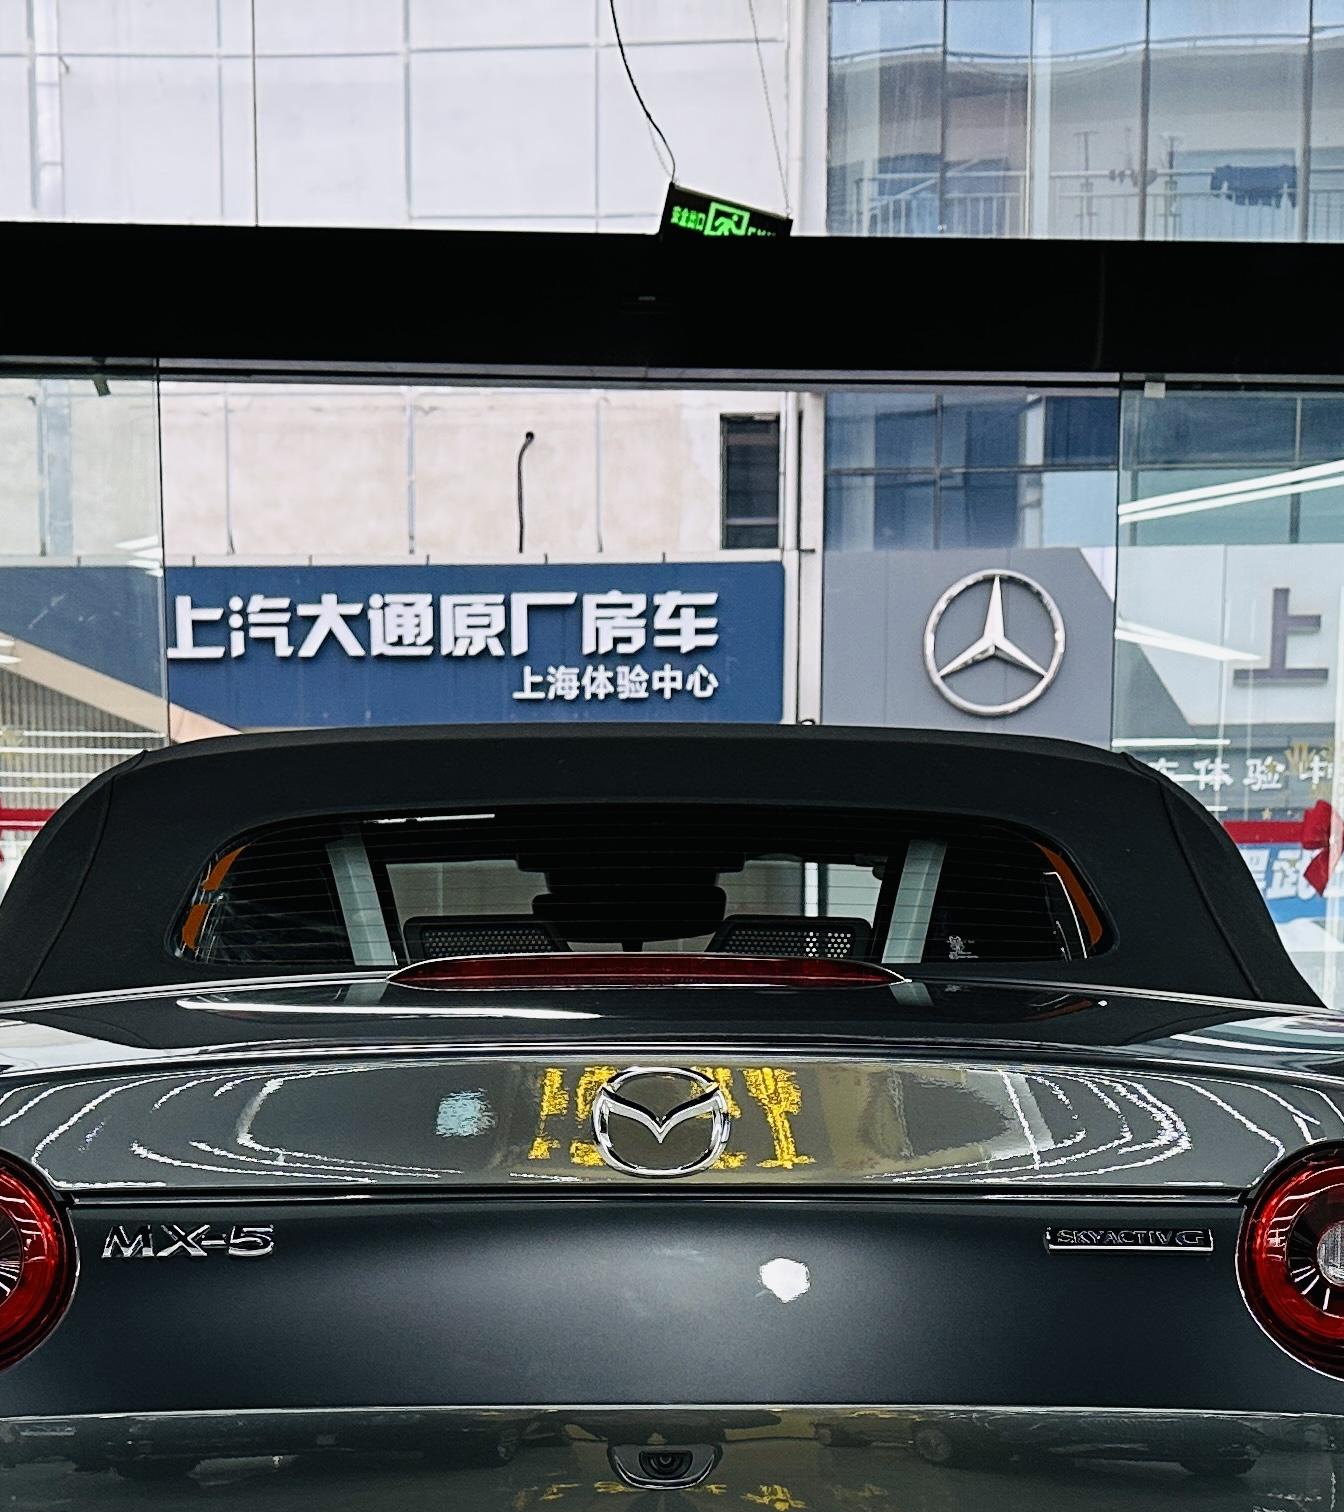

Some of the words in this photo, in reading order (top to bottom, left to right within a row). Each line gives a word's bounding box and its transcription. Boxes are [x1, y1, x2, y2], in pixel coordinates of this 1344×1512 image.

[167, 591, 719, 659] 上汽大通原厂房车
[512, 663, 719, 701] 上海体验中心
[102, 1224, 275, 1258] MX-5
[1057, 1230, 1173, 1245] SKYACTIV
